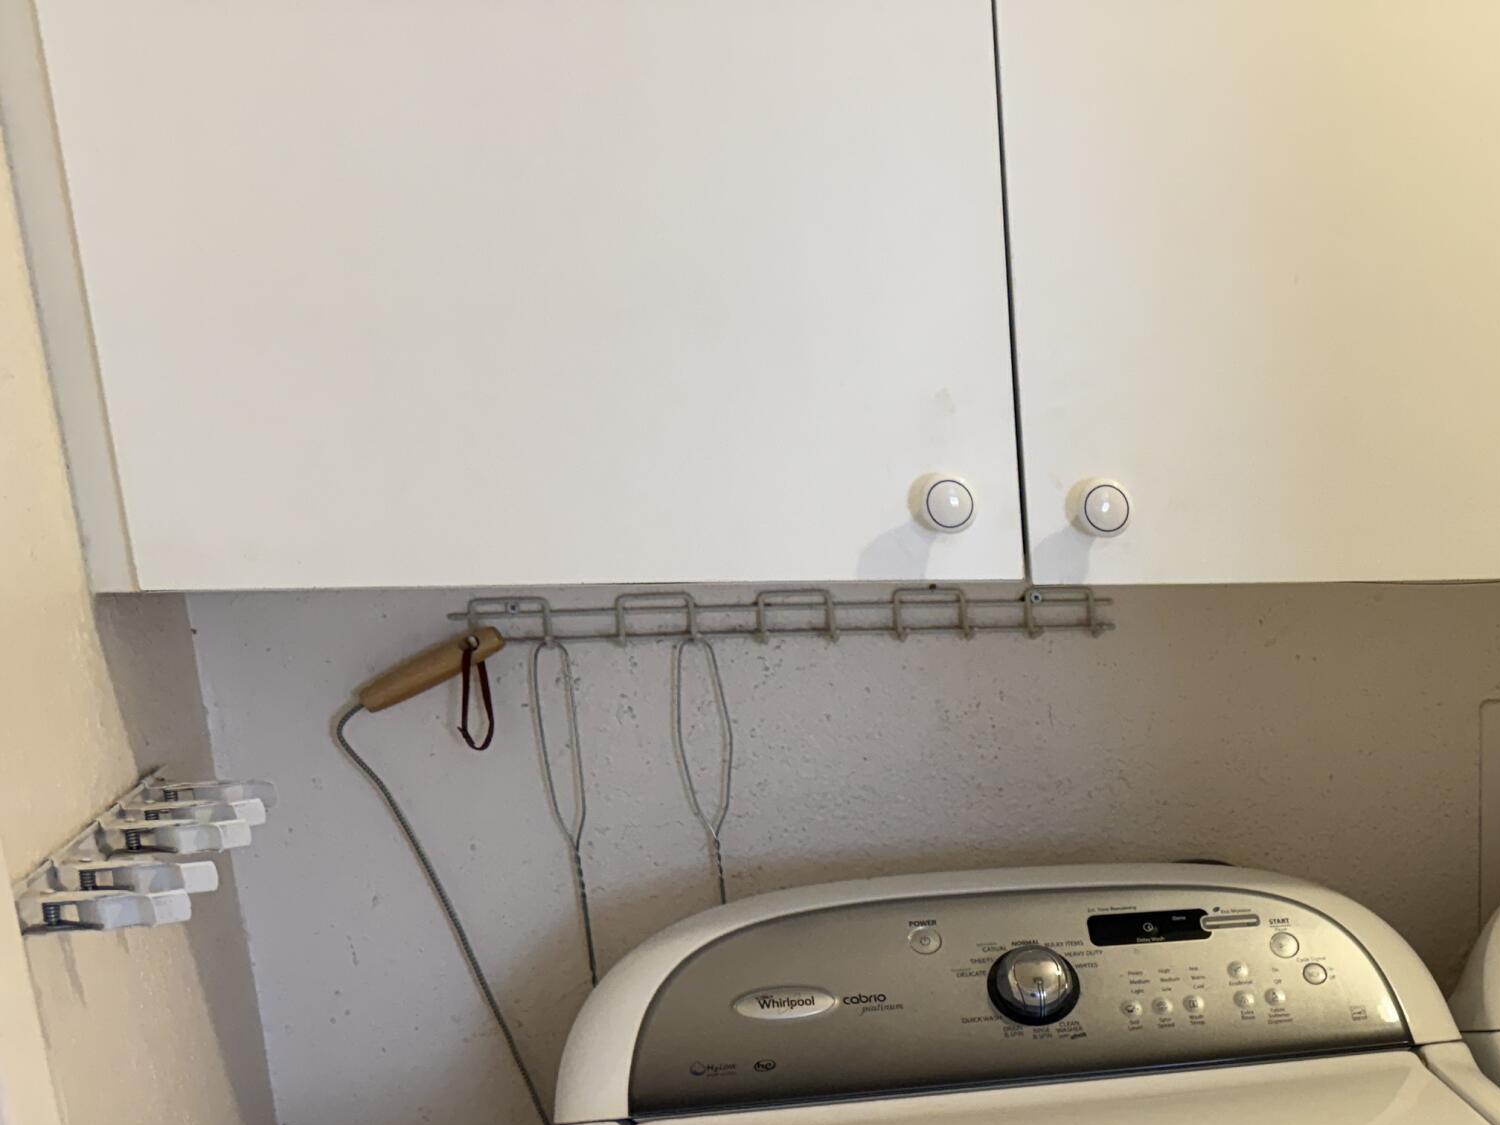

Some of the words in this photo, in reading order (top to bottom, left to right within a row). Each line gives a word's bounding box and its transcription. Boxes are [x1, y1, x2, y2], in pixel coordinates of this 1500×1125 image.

[908, 919, 937, 927] POWER
[1268, 917, 1290, 926] START
[1011, 938, 1039, 947] NORMAL
[956, 970, 988, 978] DELICATE
[757, 995, 816, 1010] Whirlpool
[842, 993, 887, 1005] cabrio
[859, 1002, 904, 1017] platinum
[961, 1016, 984, 1024] QUICK
